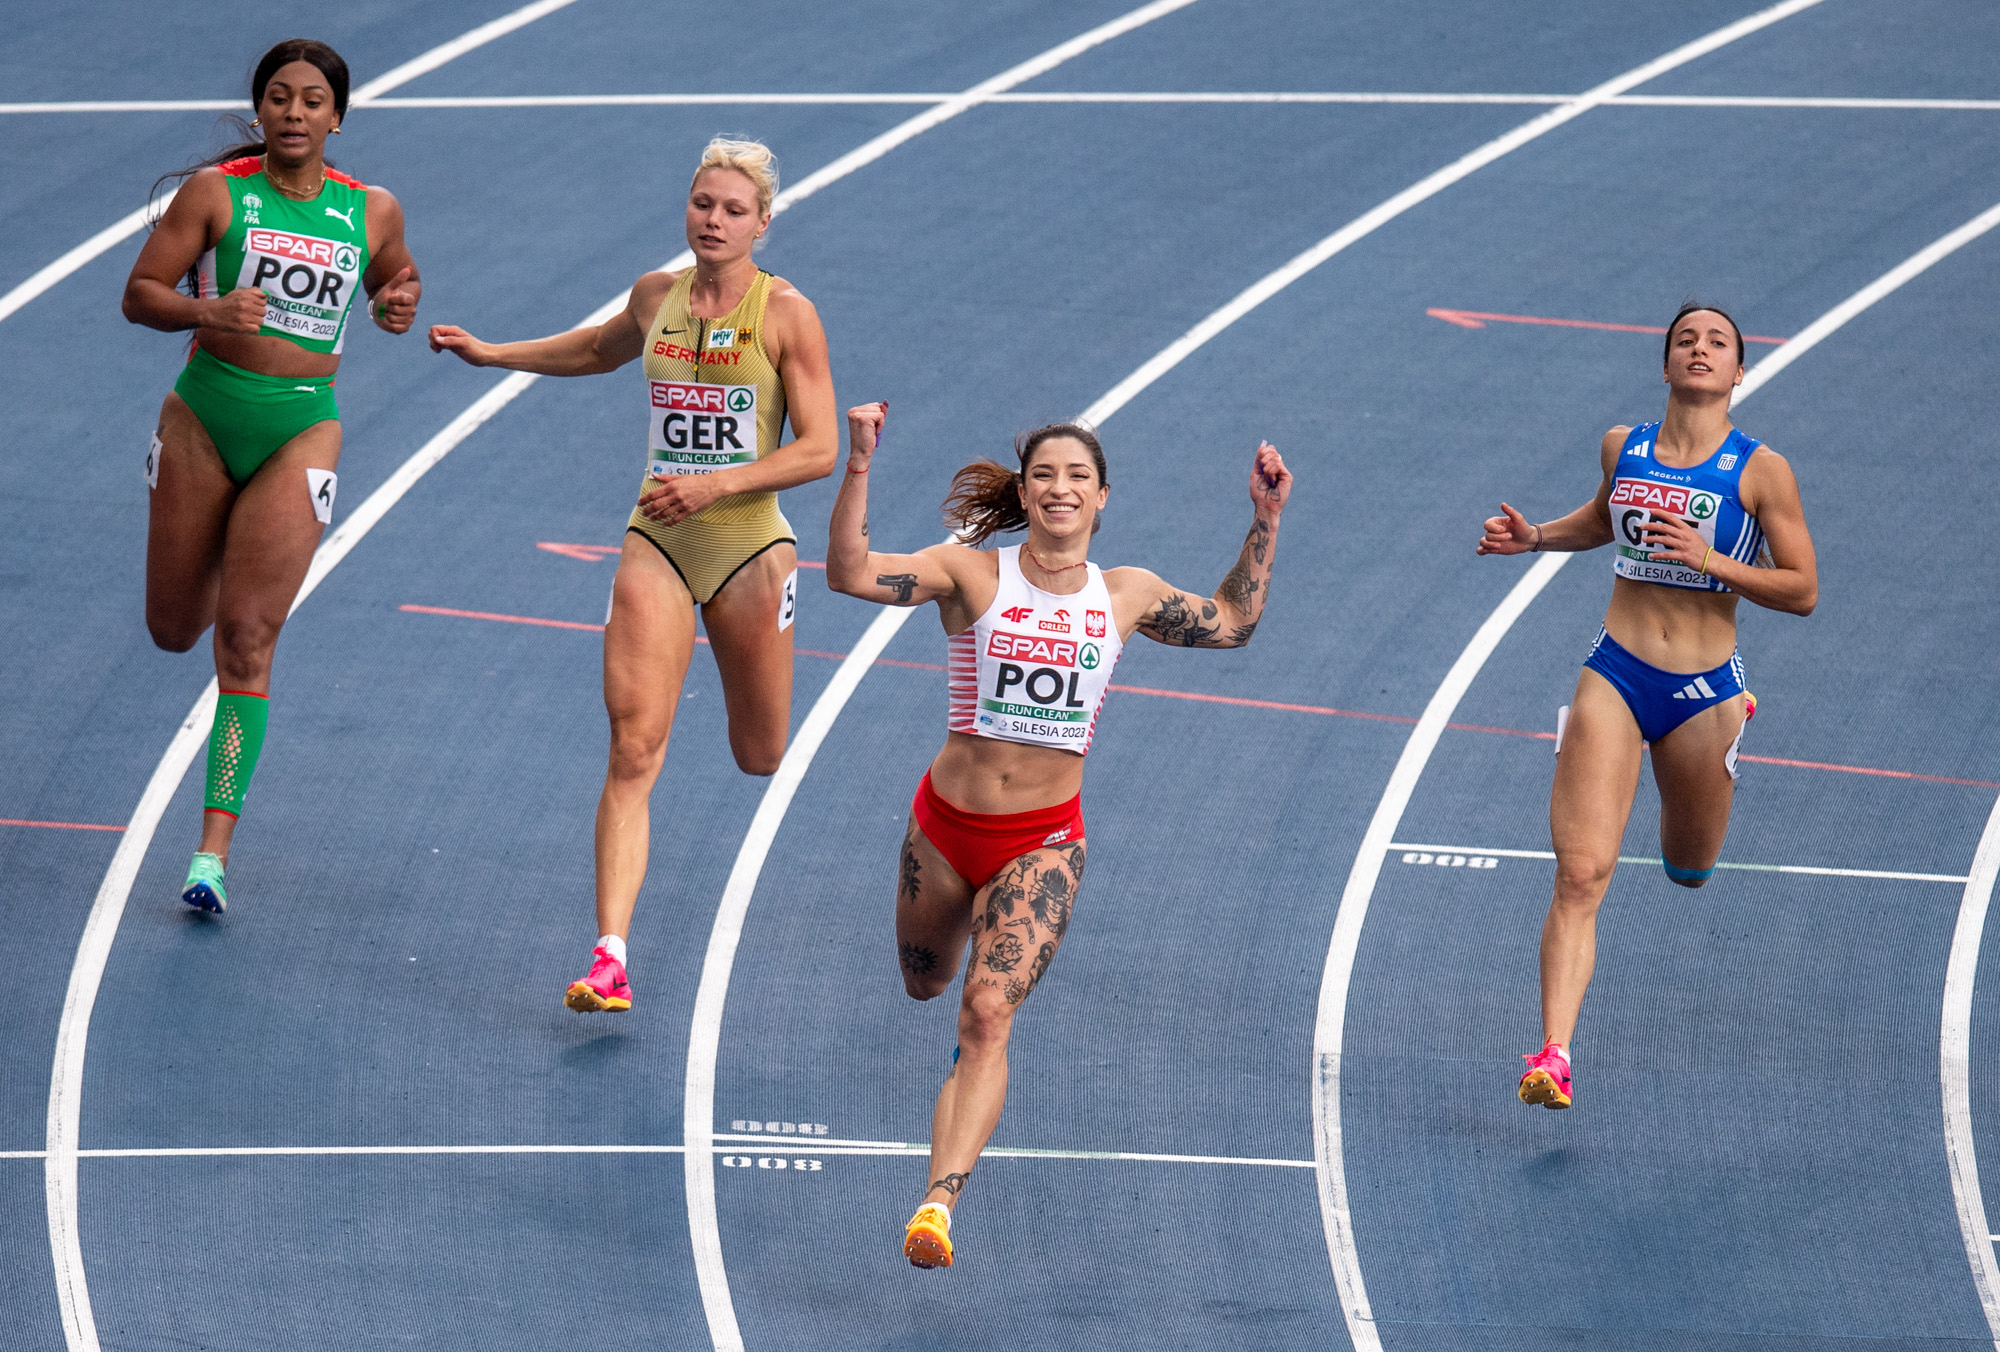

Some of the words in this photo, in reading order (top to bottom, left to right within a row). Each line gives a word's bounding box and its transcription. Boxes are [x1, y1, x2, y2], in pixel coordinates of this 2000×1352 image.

[243, 215, 260, 225] FPA
[252, 234, 332, 263] SPAR
[252, 256, 344, 307] POR
[288, 302, 323, 317] CLEAN
[266, 310, 309, 331] SILESIA
[311, 323, 336, 335] 2023
[653, 341, 742, 365] GERMANY
[653, 386, 723, 410] SPAR
[663, 412, 744, 451] GER
[672, 453, 693, 463] RUN
[694, 453, 730, 464] CLEAN
[1648, 470, 1684, 481] AEGEAN
[1614, 483, 1687, 511] SPAR
[1629, 565, 1673, 581] SILESIA
[1676, 571, 1707, 584] 2023
[785, 580, 794, 619] 5
[1001, 606, 1034, 623] 4F
[1040, 622, 1069, 632] ORLEN
[991, 634, 1075, 664] SPAR
[995, 662, 1084, 708] POL
[1001, 704, 1006, 713] I
[1007, 704, 1032, 716] RUN
[1034, 708, 1069, 720] CLEAN
[1012, 720, 1059, 737] SILESIA
[1062, 727, 1086, 738] 2023
